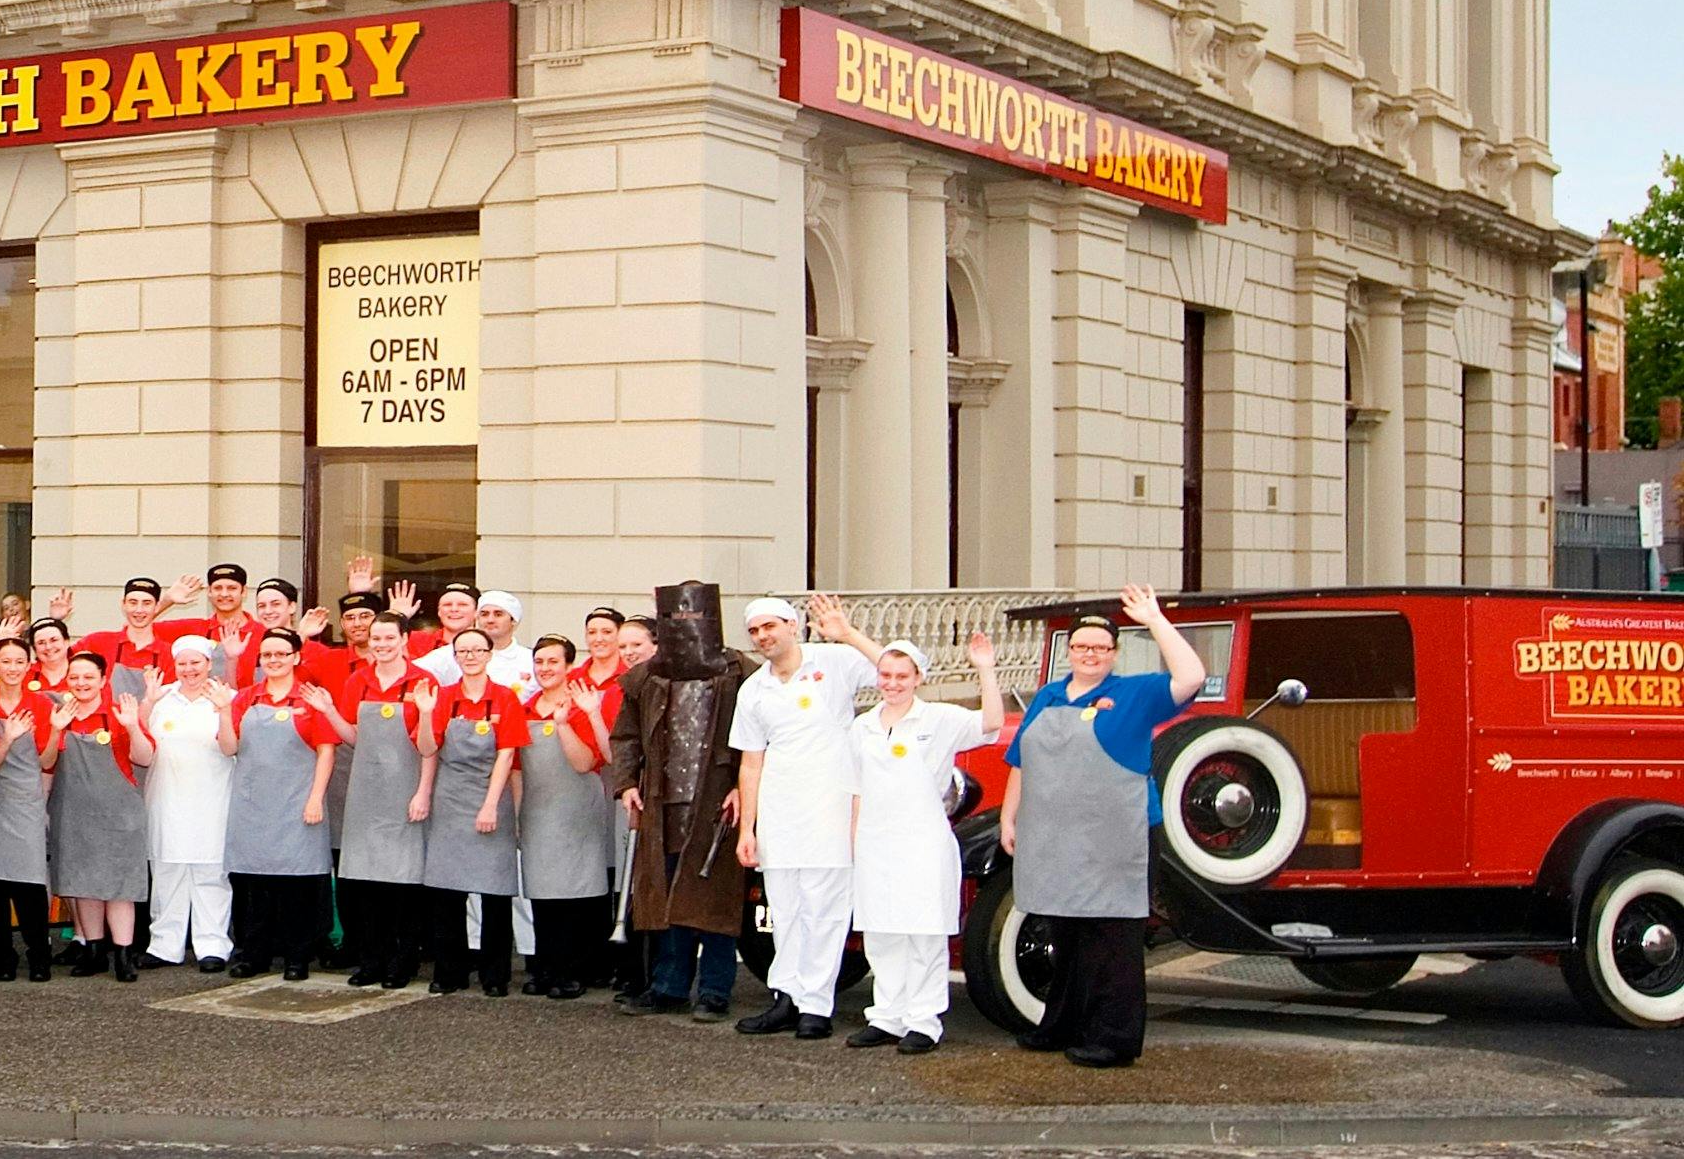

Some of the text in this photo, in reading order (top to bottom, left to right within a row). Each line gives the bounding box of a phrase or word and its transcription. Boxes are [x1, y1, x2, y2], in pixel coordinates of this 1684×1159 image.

[61, 21, 419, 128] BAKERY
[835, 28, 1207, 207] BEECHWORTH BAKERY
[370, 337, 438, 363] OPEN
[342, 369, 392, 394] 6AM
[416, 367, 466, 392] 6PM
[361, 398, 445, 423] 7 DAYS
[1567, 674, 1684, 707] BAKER
